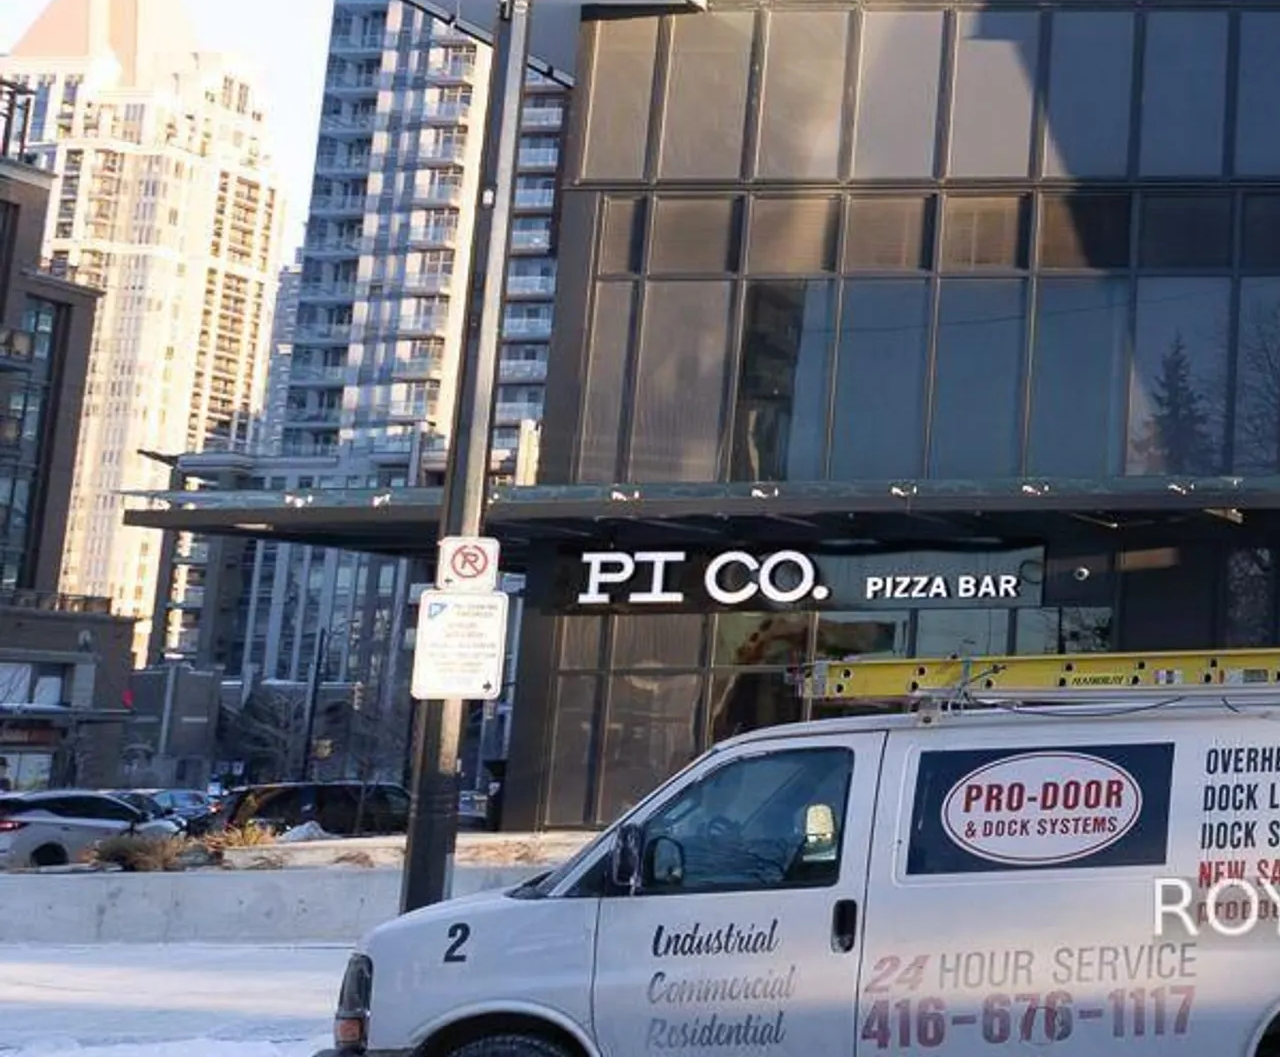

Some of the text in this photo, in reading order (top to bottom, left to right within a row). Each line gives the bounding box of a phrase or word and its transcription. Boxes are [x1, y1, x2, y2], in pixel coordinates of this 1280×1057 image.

[577, 549, 831, 605] PI CO.
[866, 575, 1019, 600] PIZZA BAR
[963, 779, 1125, 814] PRO-DOOR
[1203, 783, 1259, 812] DOCK
[965, 816, 1118, 839] & DOCK SYSTEMS
[1201, 820, 1257, 850] DOCK
[1199, 859, 1247, 889] NEW
[443, 922, 472, 963] 2
[651, 919, 779, 958] Industrial
[647, 965, 798, 1005] Commercial
[864, 942, 1198, 993] 24 HOUR SERVICE
[649, 1010, 787, 1049] Residential
[861, 985, 1196, 1050] 416-676-1117
